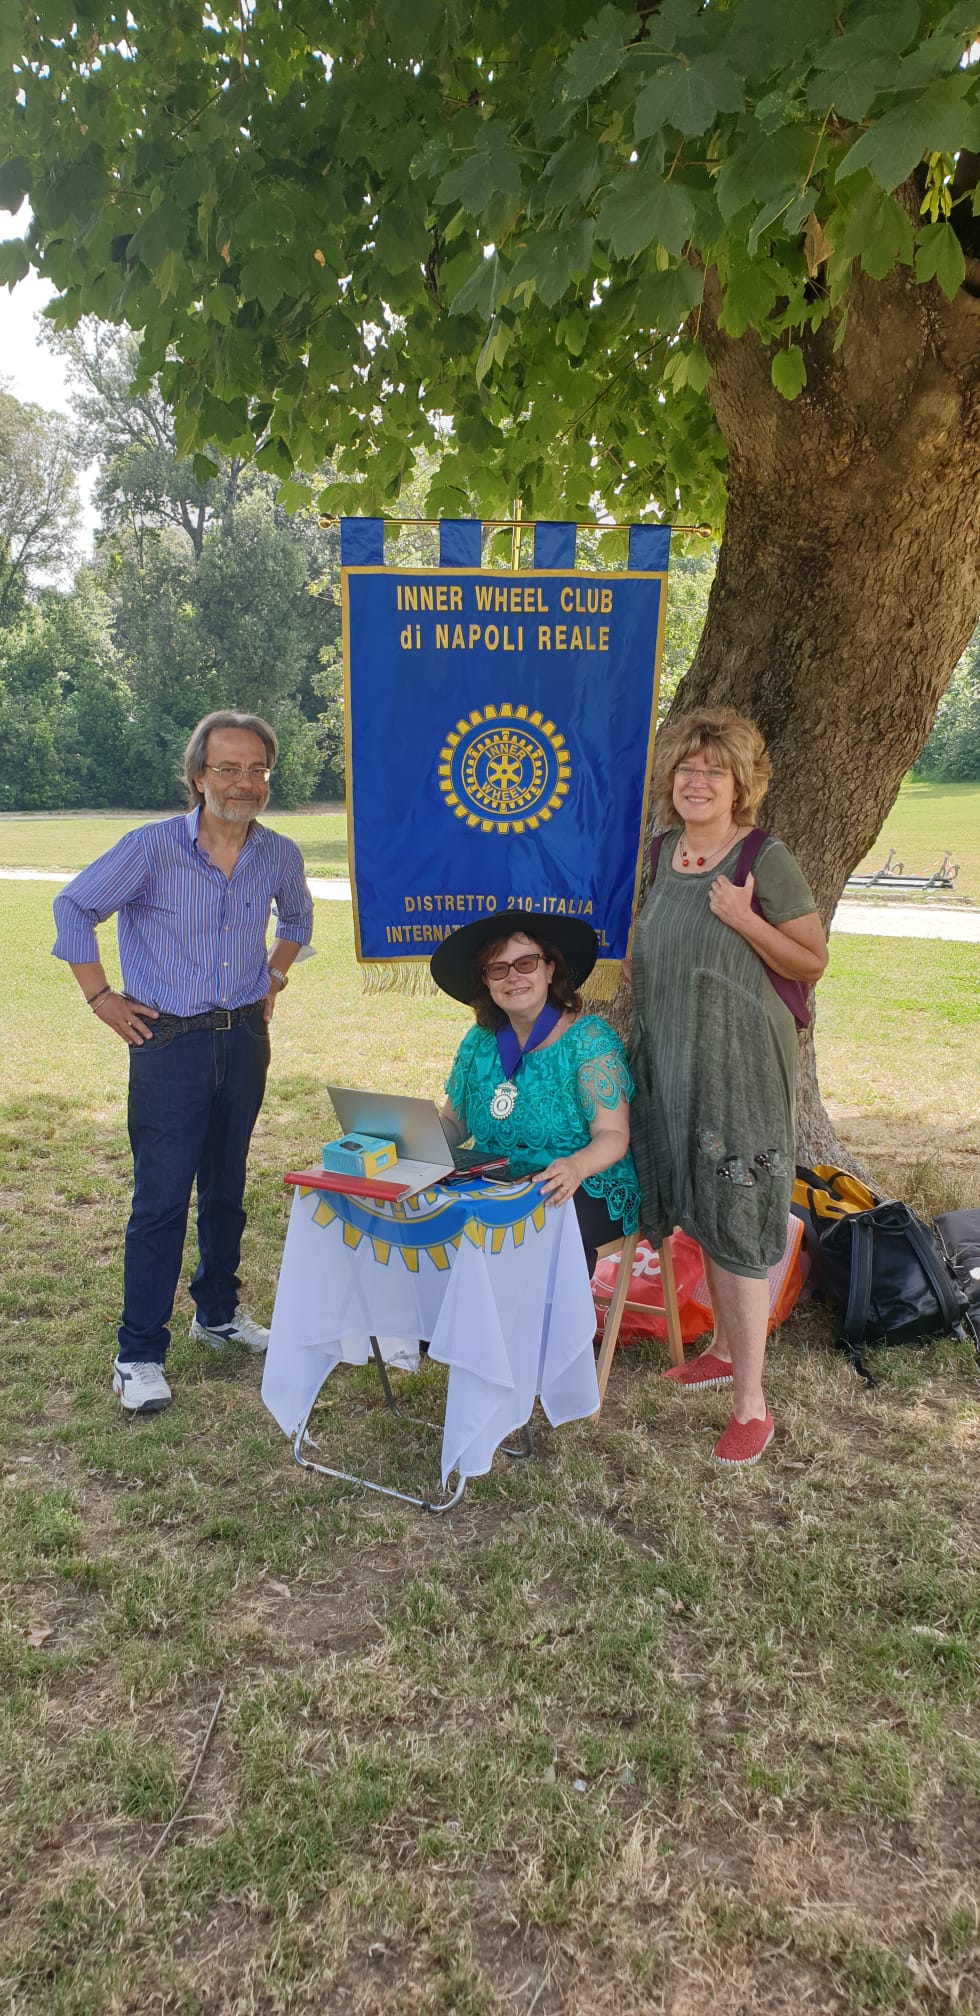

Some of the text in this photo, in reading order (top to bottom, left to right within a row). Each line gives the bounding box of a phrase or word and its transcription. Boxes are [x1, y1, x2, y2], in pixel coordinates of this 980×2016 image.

[396, 585, 613, 614] INNER WHEEL CLUB
[400, 624, 610, 651] di NAPOLI REALE
[484, 743, 527, 761] INNER
[481, 781, 527, 801] WHEEL
[404, 895, 593, 916] DISTRETTO 210-ITALIA
